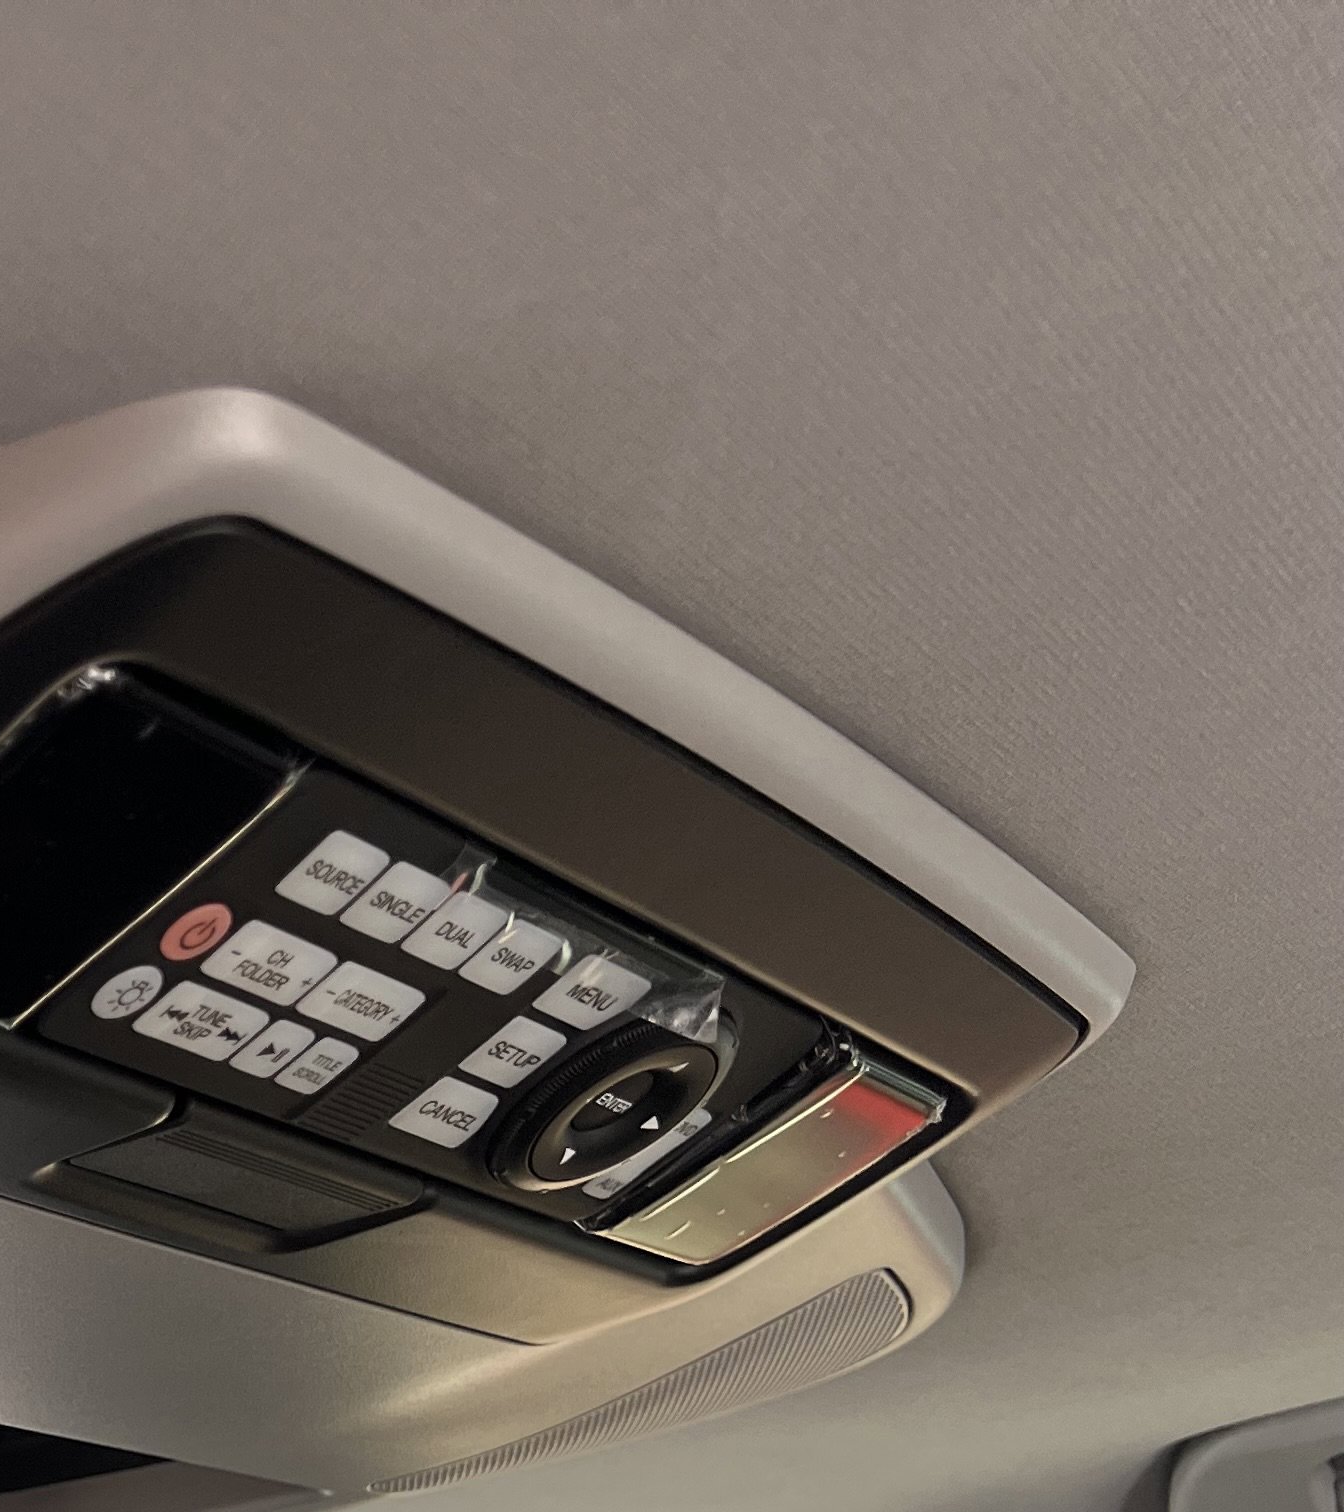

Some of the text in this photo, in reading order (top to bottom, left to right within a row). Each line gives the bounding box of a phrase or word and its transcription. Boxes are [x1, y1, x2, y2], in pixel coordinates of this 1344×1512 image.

[305, 859, 366, 896] SOURCE
[369, 890, 426, 924] SINGLE
[435, 920, 476, 949] DUAL
[266, 949, 295, 968] CH
[490, 946, 536, 973] SWAP
[232, 959, 290, 992] FOLDER
[333, 989, 394, 1021] CATEGORY
[565, 983, 619, 1013] MENU
[173, 1021, 212, 1041] SKIP
[192, 1004, 233, 1029] TUNE
[312, 1053, 343, 1073] TITLE
[487, 1040, 542, 1069] SETUP
[292, 1066, 327, 1086] SCROLL
[418, 1100, 478, 1132] CANCEL
[595, 1092, 633, 1115] ENTER
